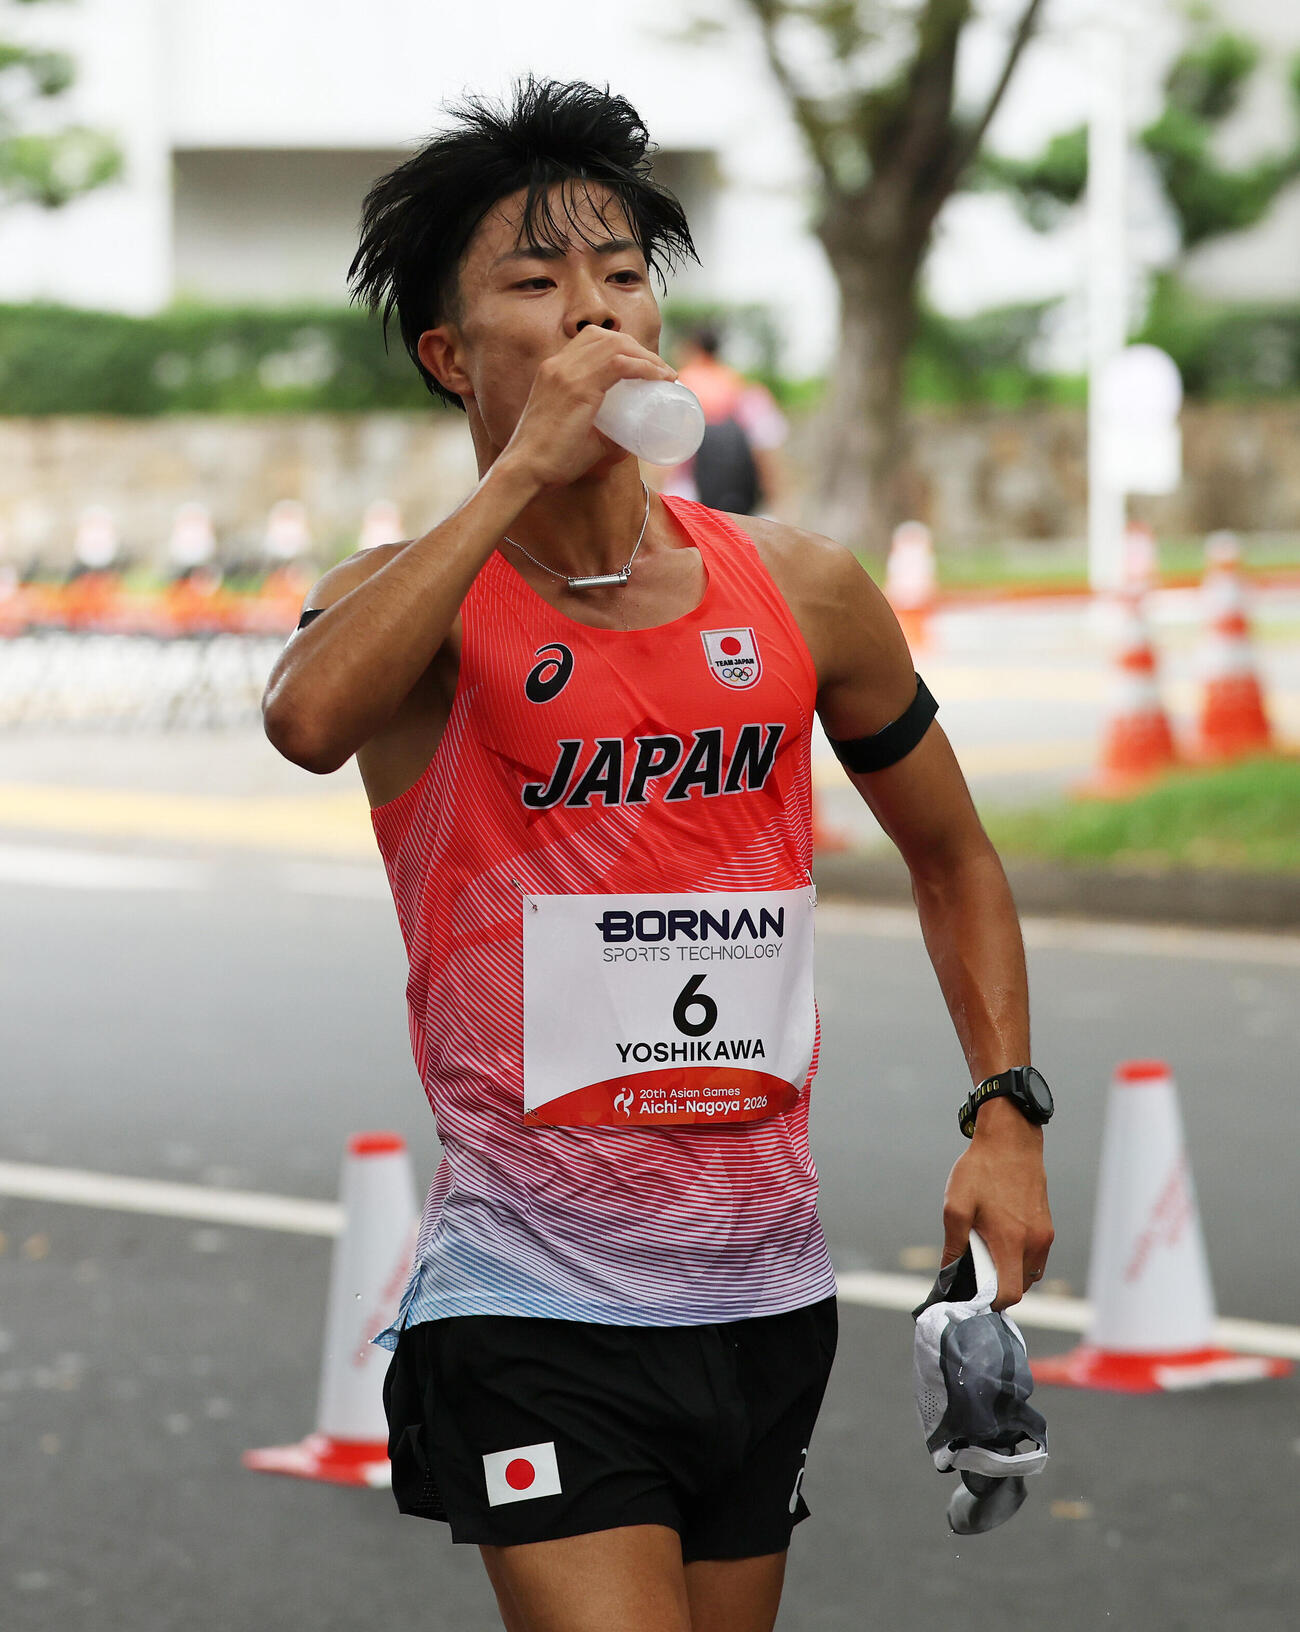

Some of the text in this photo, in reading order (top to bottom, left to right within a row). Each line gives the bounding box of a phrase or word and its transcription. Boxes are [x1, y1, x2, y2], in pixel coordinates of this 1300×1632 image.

[715, 659, 734, 667] TEAM
[522, 723, 786, 810] JAPAN
[595, 907, 785, 942] BORNAN
[603, 943, 783, 962] SPORTS TECHNOLOGY
[673, 974, 718, 1037] 6
[616, 1039, 766, 1063] YOSHIKAWA
[640, 1087, 741, 1098] 20th Asian Games
[640, 1096, 768, 1116] Aichi-Nagoya 2026
